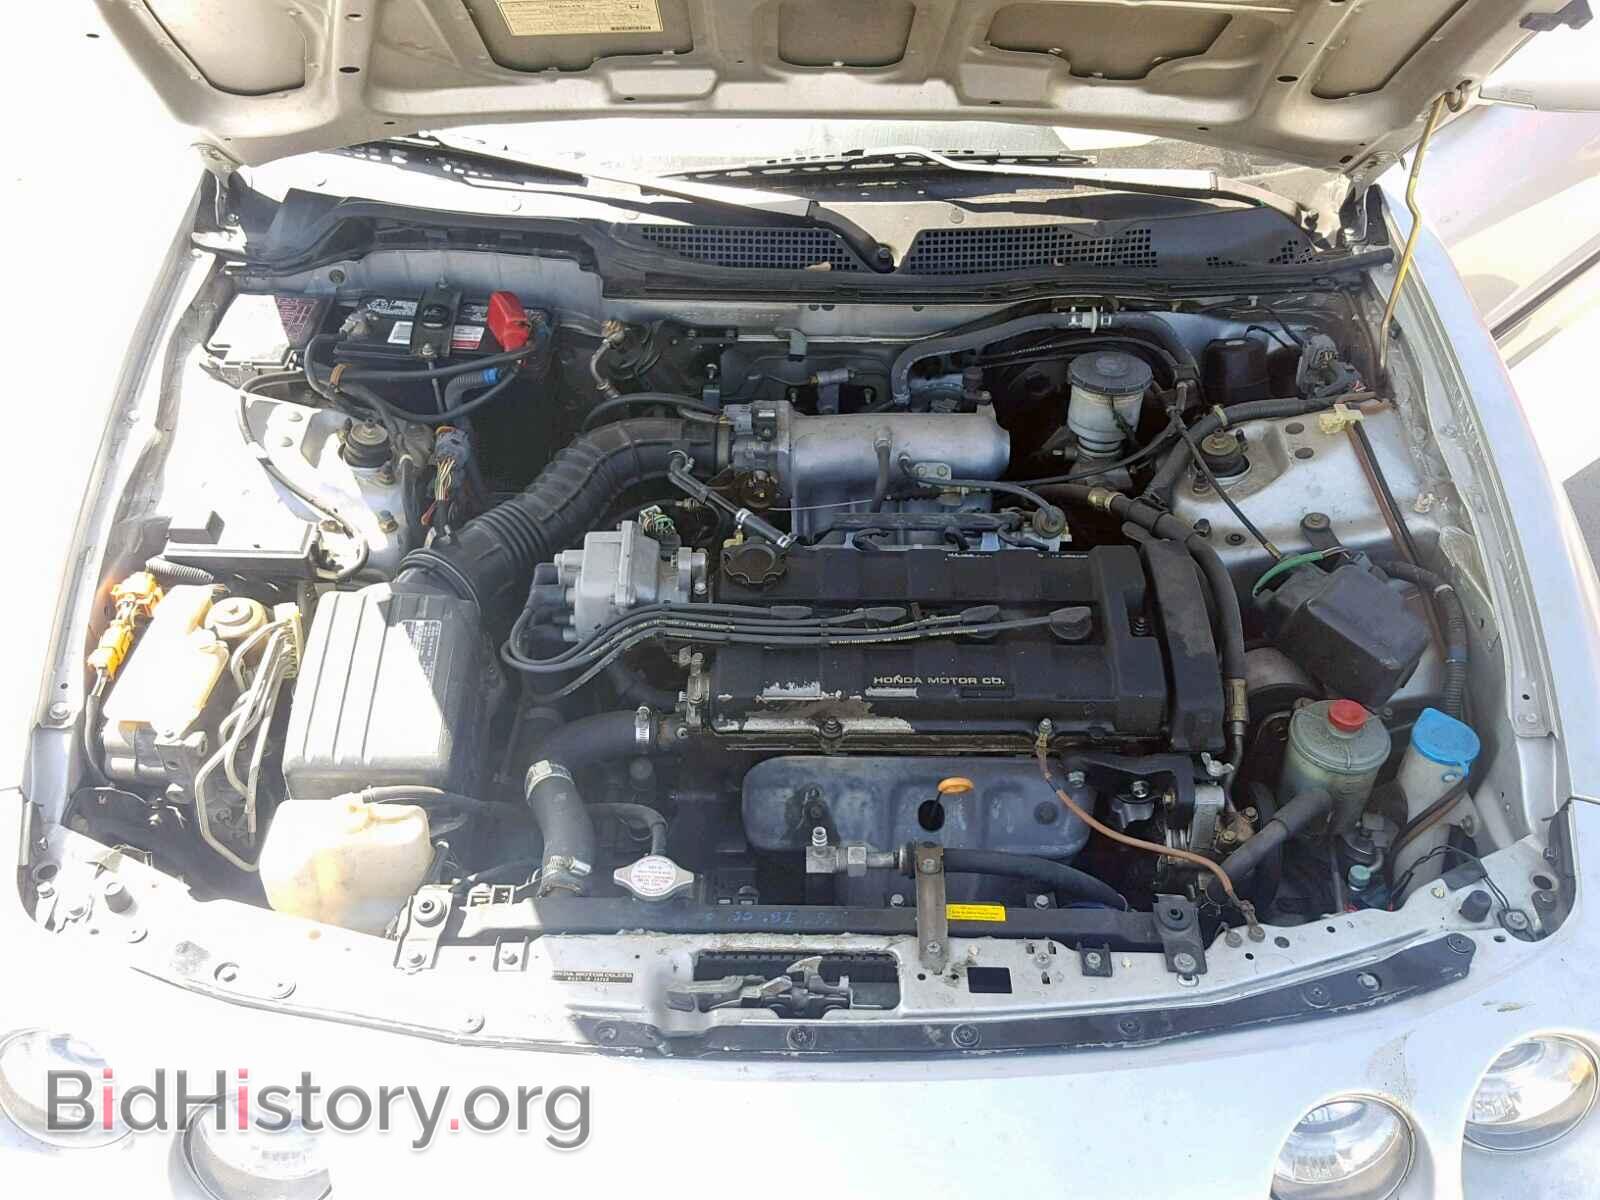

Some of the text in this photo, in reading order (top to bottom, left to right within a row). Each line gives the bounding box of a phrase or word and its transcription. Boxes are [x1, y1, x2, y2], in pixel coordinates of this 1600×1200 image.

[873, 675, 1005, 685] HONDA MOTOR CO.
